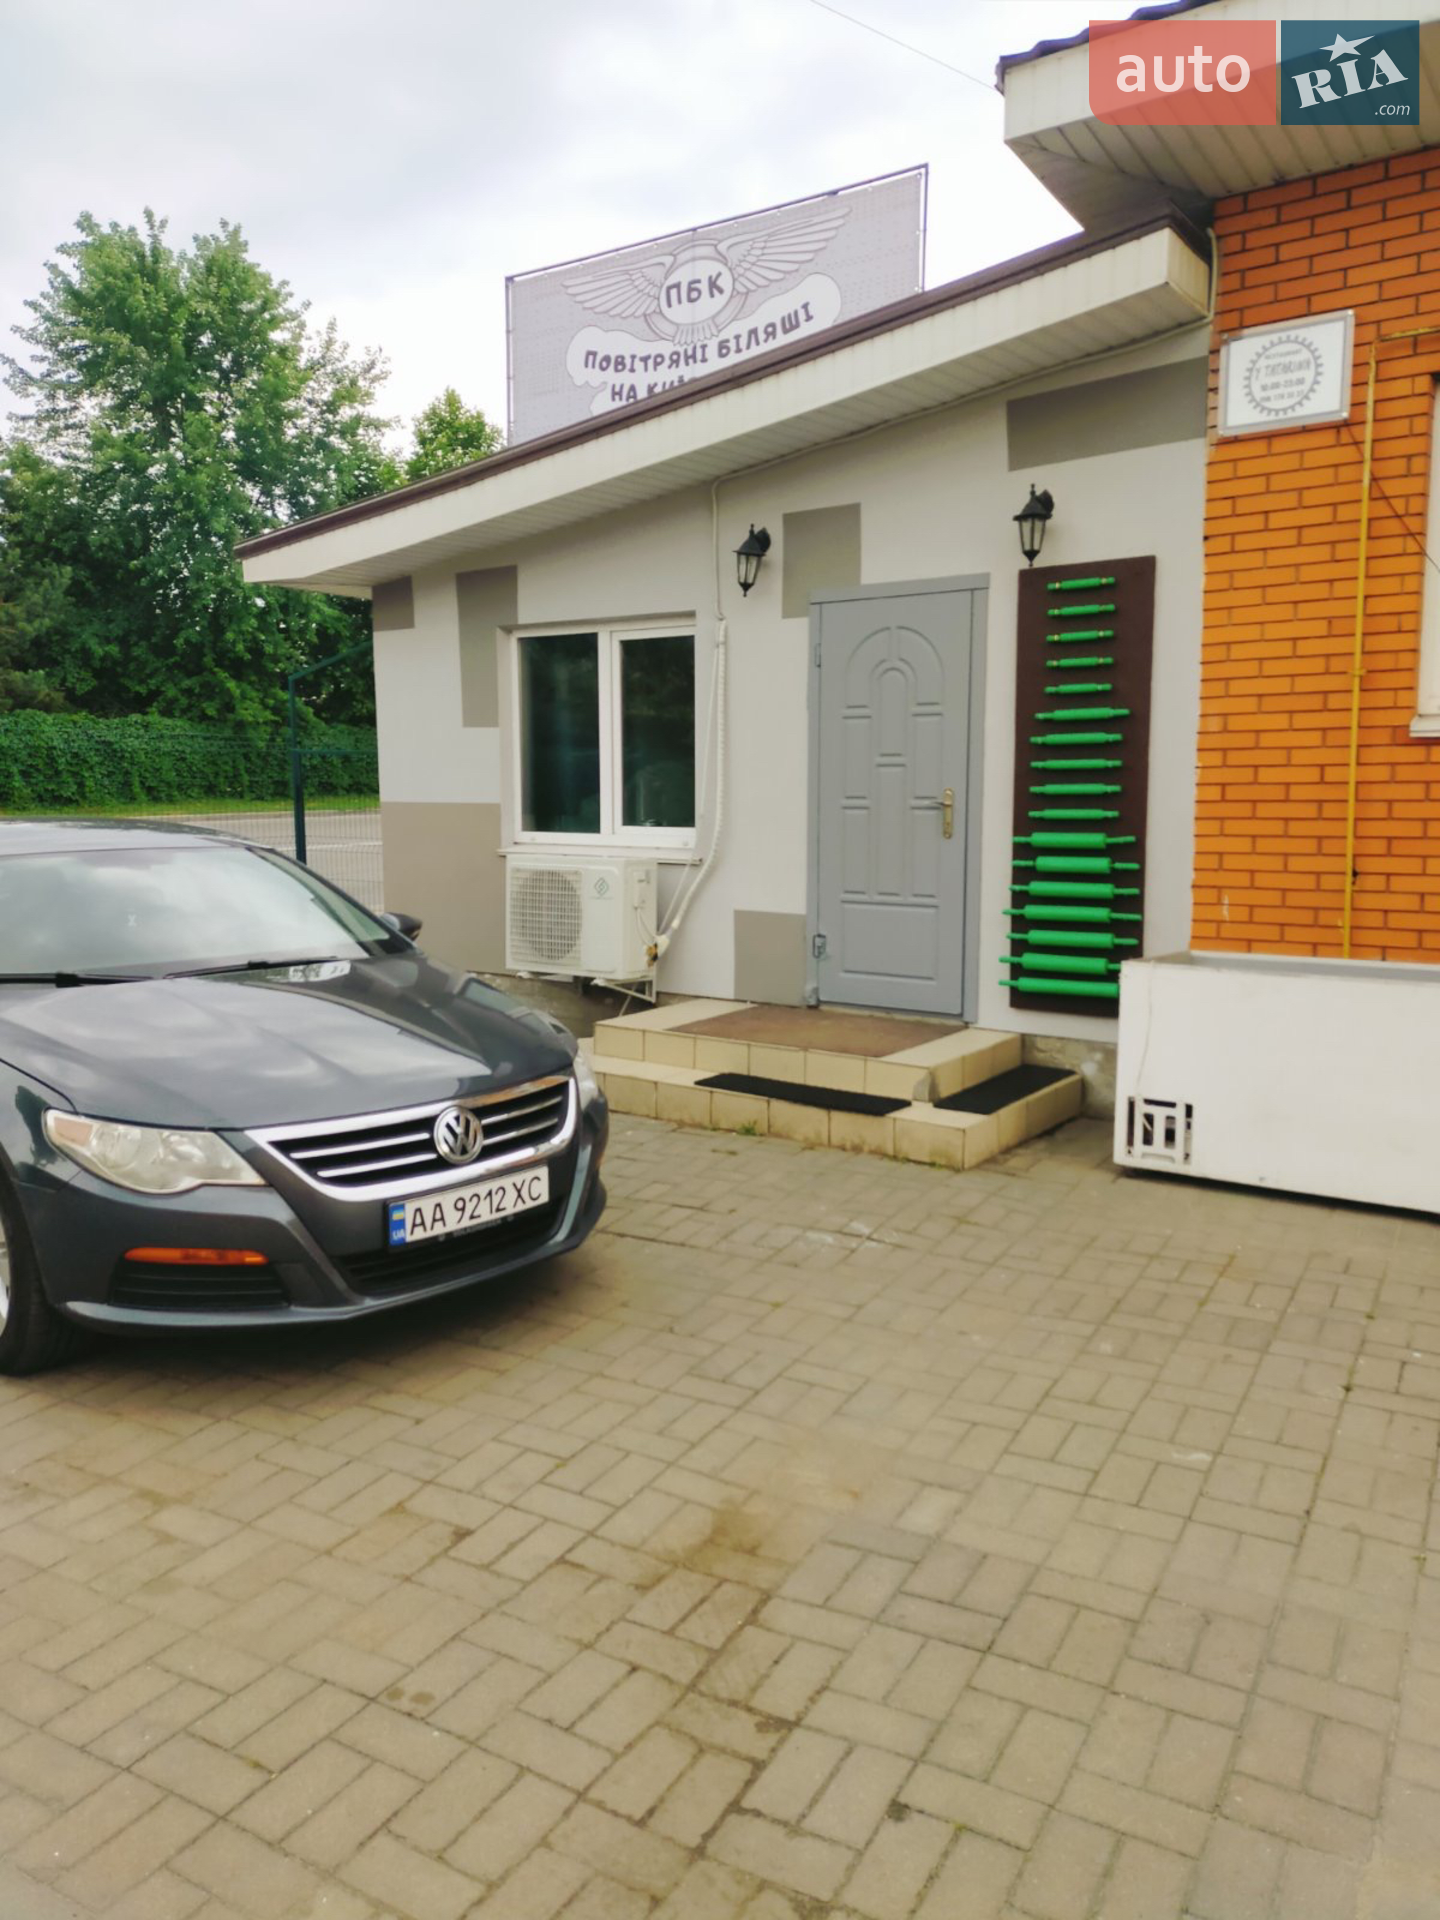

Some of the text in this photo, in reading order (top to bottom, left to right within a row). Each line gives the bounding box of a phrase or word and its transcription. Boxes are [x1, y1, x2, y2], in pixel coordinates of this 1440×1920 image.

[665, 271, 725, 308] ПБК
[584, 302, 815, 373] ПОВІТРЯНІ БІЛЯШІ
[611, 383, 638, 402] НА
[410, 1202, 447, 1236] AA
[453, 1186, 507, 1224] 9212
[512, 1176, 542, 1207] XC
[392, 1229, 405, 1240] UA
